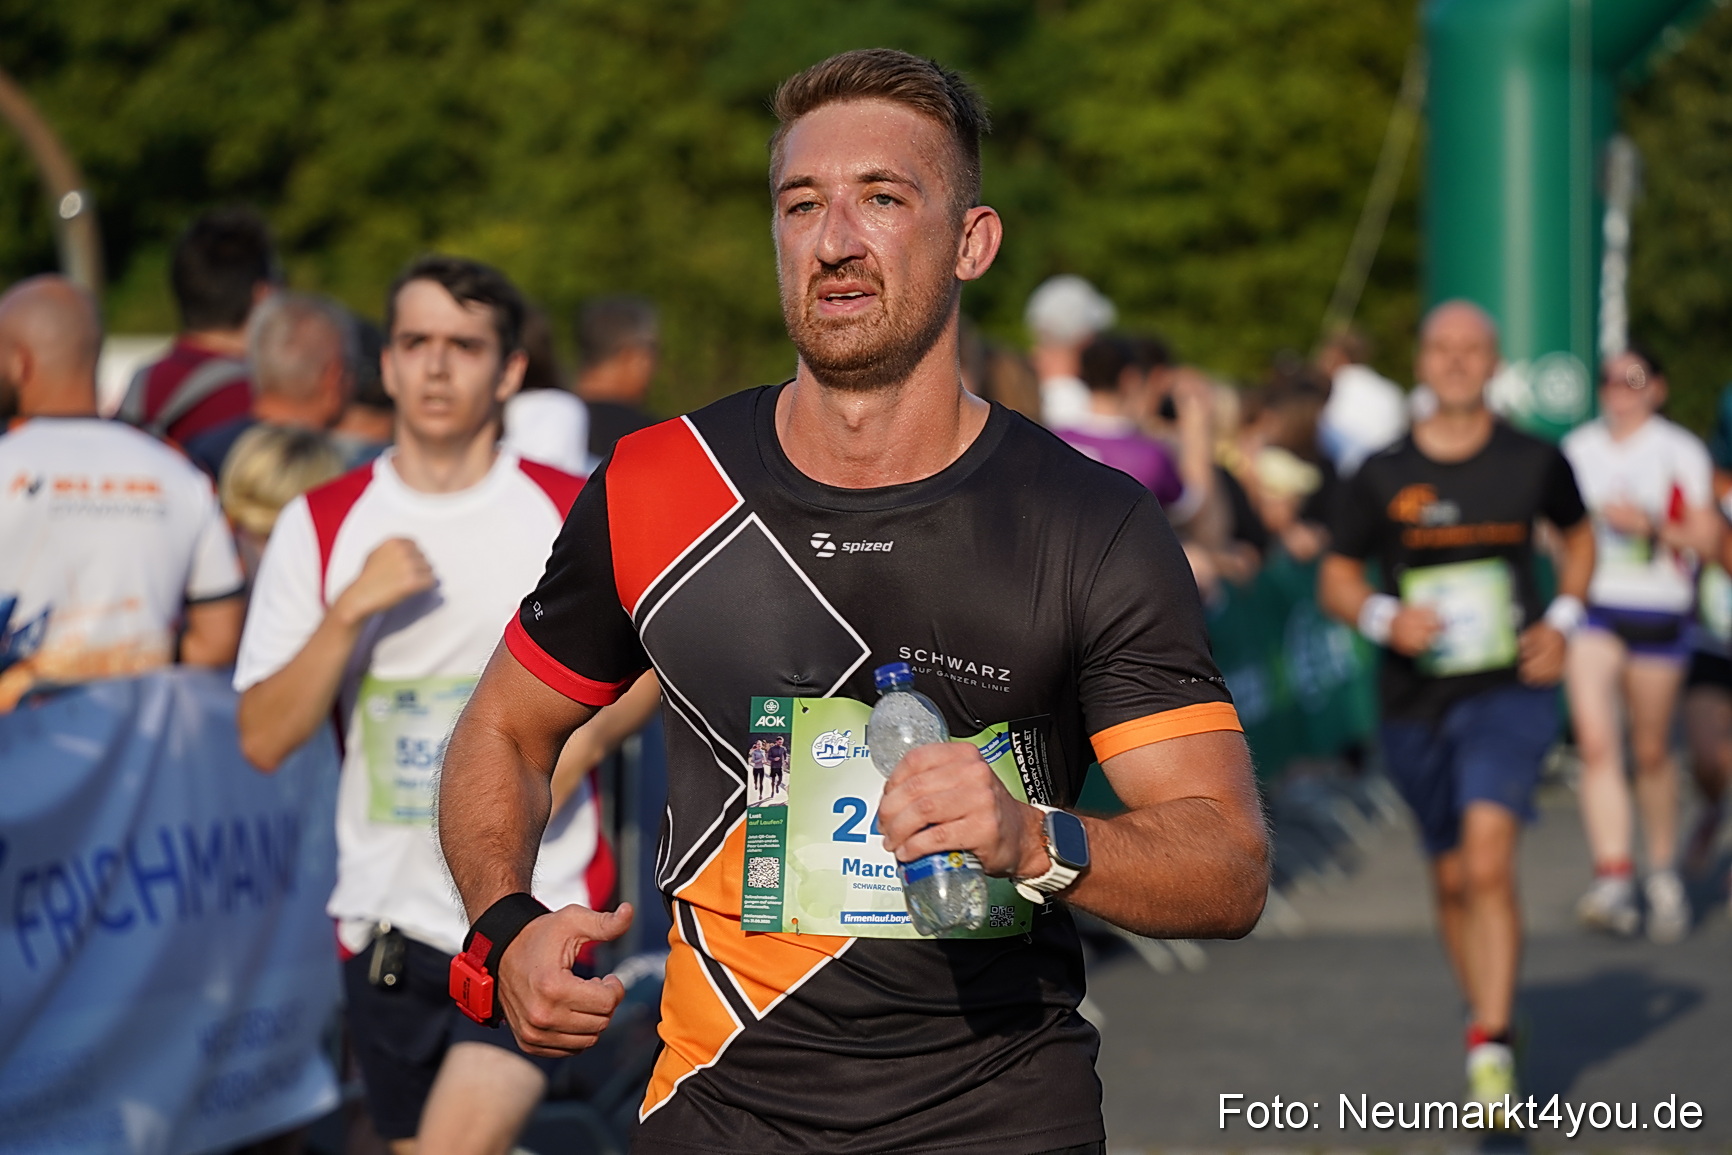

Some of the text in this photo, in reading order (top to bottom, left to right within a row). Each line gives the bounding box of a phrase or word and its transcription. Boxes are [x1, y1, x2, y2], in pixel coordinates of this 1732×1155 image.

[841, 540, 894, 554] spized
[899, 646, 1011, 682] SCHWARZ
[911, 665, 1011, 693] AUF GANZER LINIE
[755, 715, 786, 727] AOK
[1011, 731, 1031, 784] RABATT
[1023, 729, 1035, 766] OUTLET
[853, 883, 886, 891] SCHWARZ
